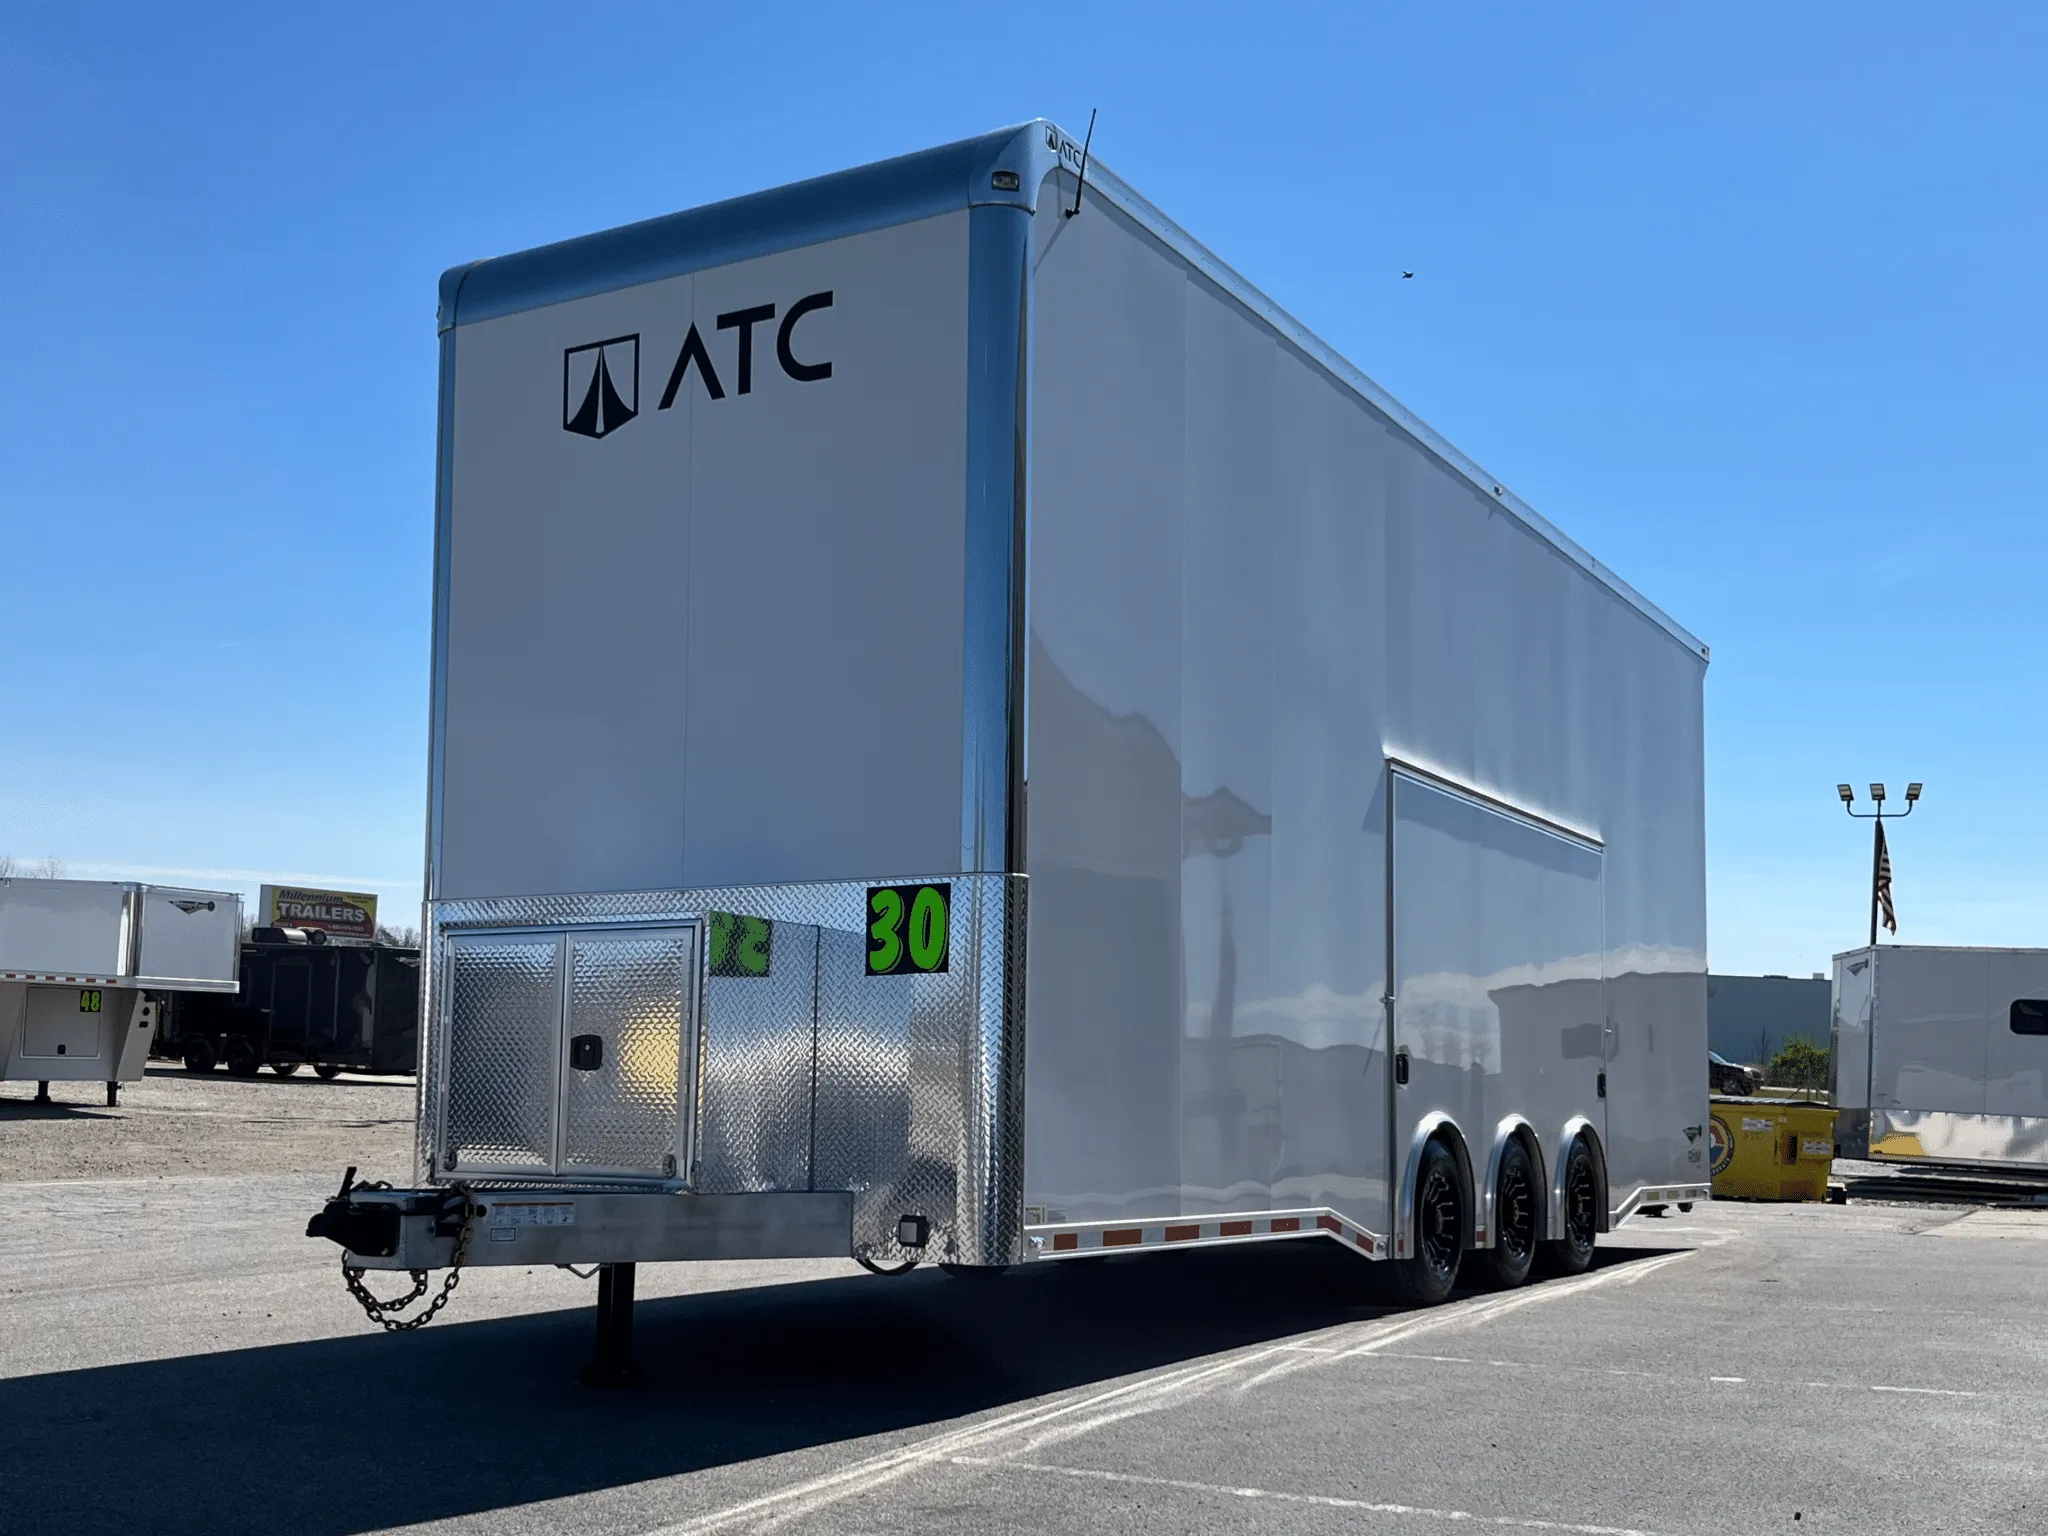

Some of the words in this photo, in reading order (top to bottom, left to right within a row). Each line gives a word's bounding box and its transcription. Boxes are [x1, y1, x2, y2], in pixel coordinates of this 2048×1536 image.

[1059, 140, 1081, 170] ATC
[657, 290, 834, 411] ATC
[278, 902, 365, 921] TRAILERS
[279, 889, 344, 904] Millennium
[868, 886, 948, 973] 30
